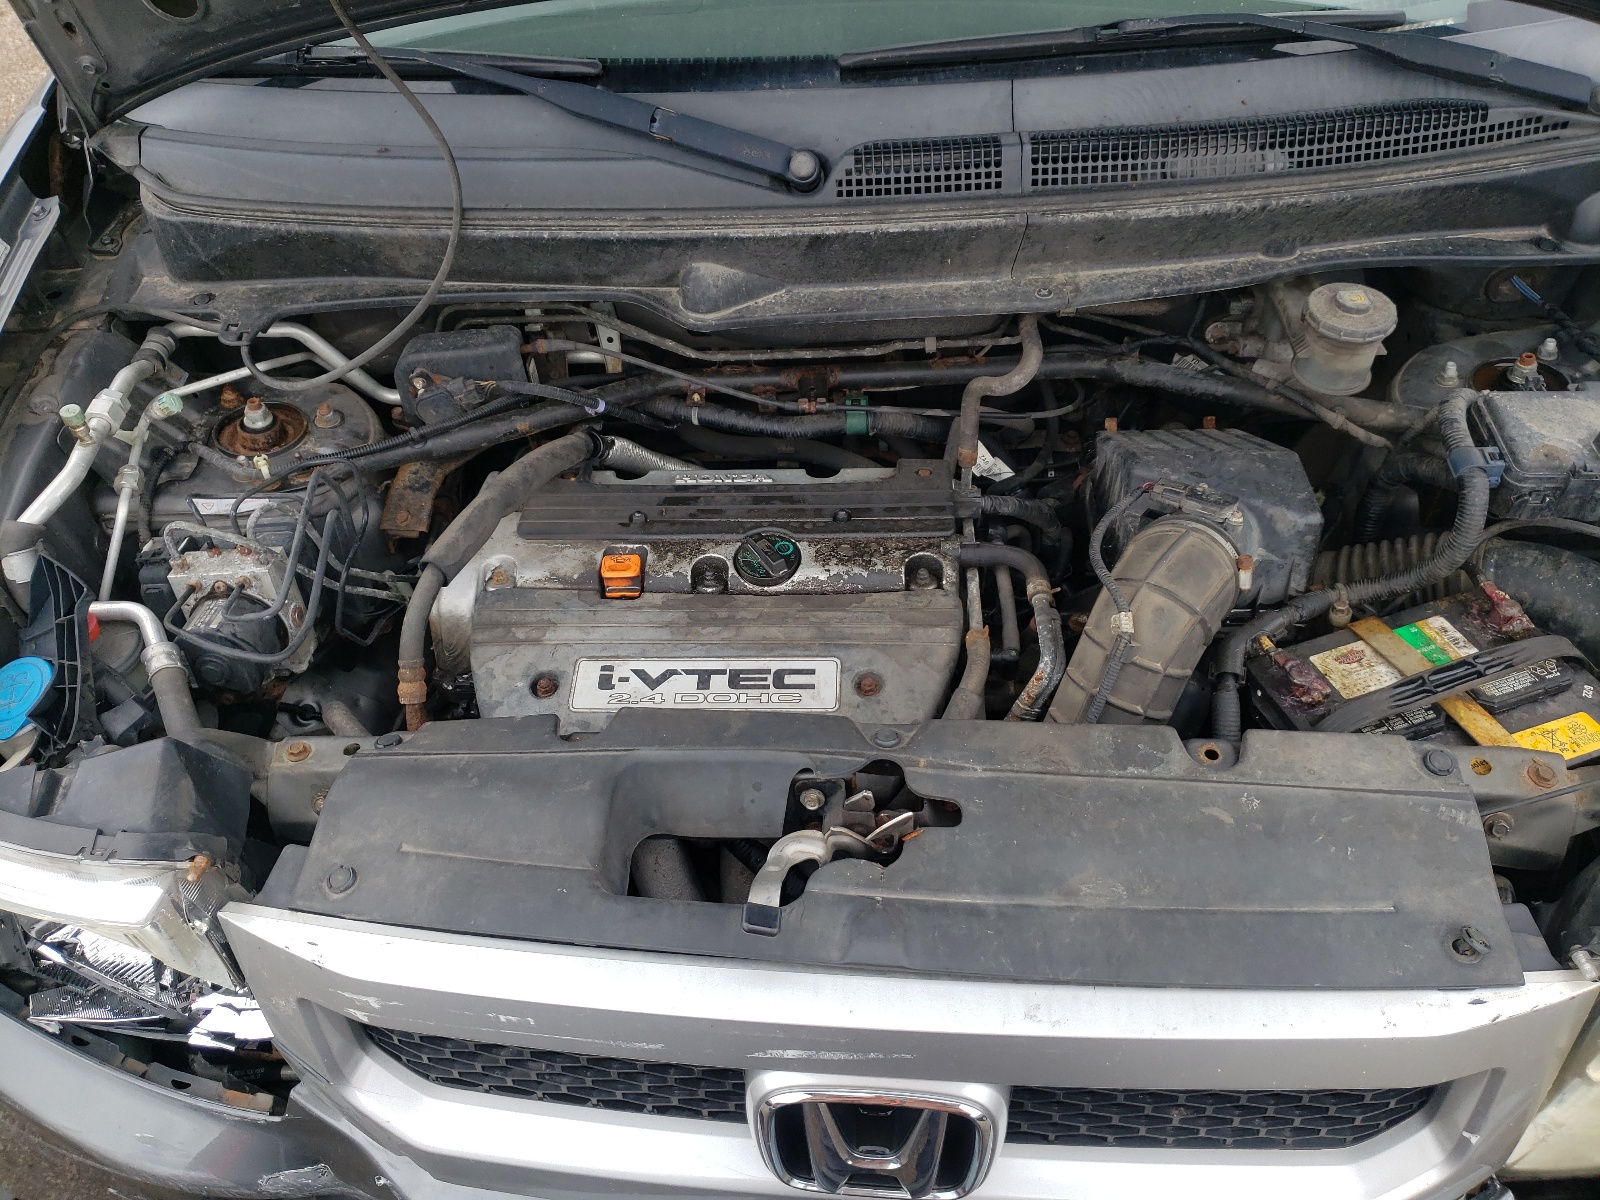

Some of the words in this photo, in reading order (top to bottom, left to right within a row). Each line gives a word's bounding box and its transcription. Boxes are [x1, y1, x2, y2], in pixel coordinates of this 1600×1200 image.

[675, 474, 773, 483] HONDA
[597, 664, 816, 692] i-VTEC
[607, 692, 665, 704] 2.4
[674, 692, 802, 704] DOHC
